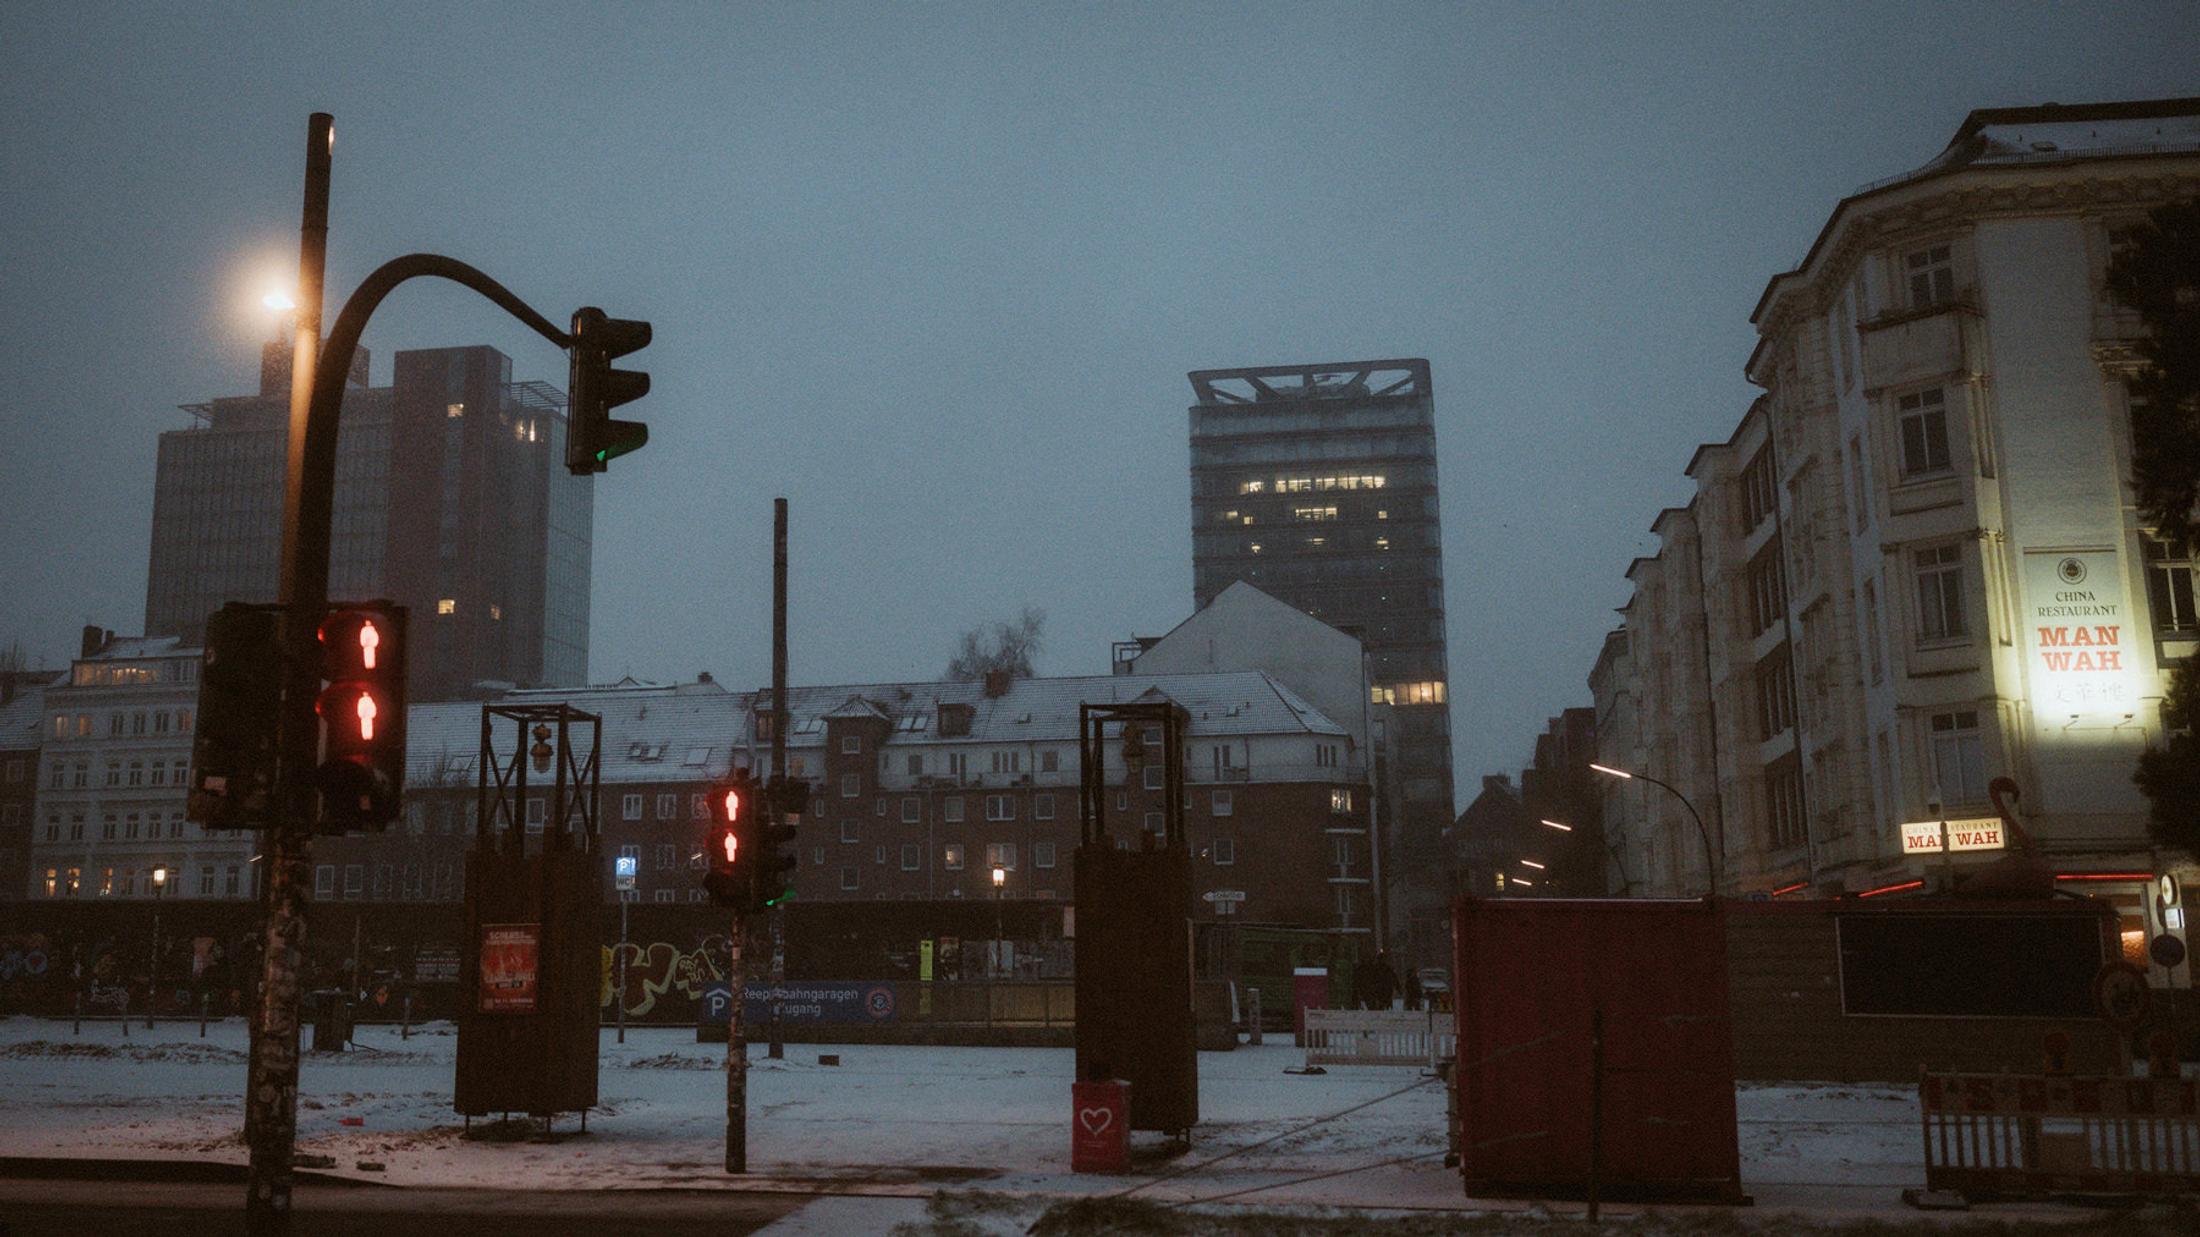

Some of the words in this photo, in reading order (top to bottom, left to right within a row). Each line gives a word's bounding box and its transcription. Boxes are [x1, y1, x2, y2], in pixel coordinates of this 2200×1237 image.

[2056, 591, 2095, 602] CHINA
[2038, 605, 2117, 617] RESTAURANT
[2038, 626, 2120, 647] MAN
[2042, 651, 2122, 671] WAH
[1956, 831, 2000, 845] WAH
[712, 997, 725, 1016] P
[782, 1003, 821, 1017] ugang
